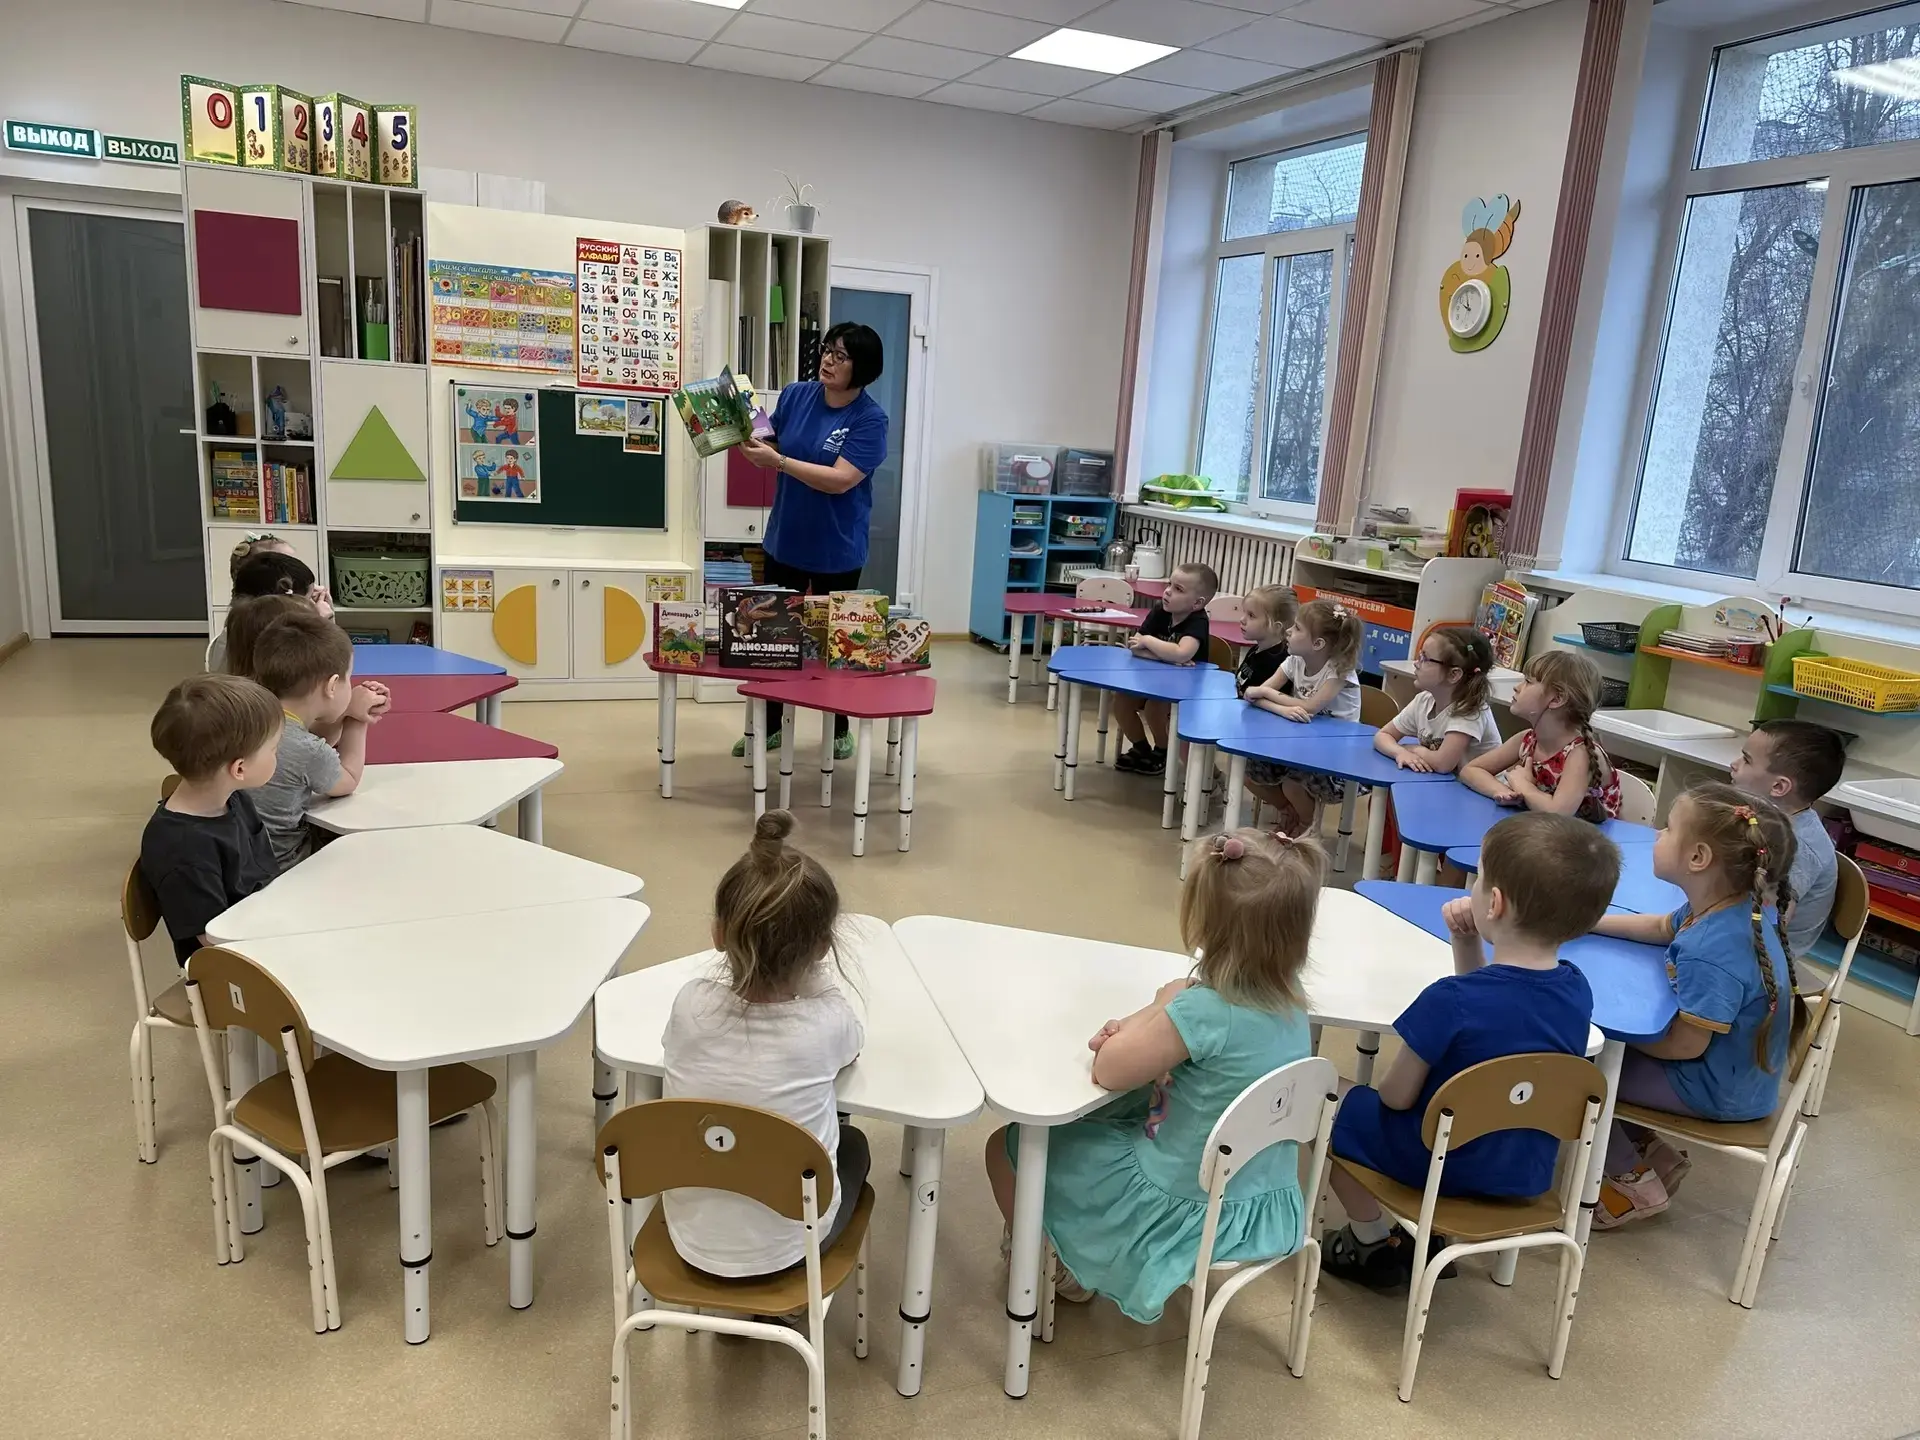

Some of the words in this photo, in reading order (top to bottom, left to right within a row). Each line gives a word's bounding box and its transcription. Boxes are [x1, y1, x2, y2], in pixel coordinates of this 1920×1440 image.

[207, 93, 232, 128] 0
[255, 96, 266, 131] 1
[294, 105, 308, 140] 2
[323, 106, 333, 141] 3
[352, 112, 368, 146] 4
[13, 126, 90, 151] ВЫХОД
[391, 115, 408, 150] 5
[108, 140, 176, 162] ВЫХОД
[579, 243, 619, 254] РУССКИЙ
[579, 252, 618, 262] АЛФАВИТ
[623, 248, 636, 258] Аа
[644, 250, 657, 260] Бб
[665, 252, 676, 262] Вв
[432, 262, 466, 273] Учимся
[583, 264, 592, 273] Гг
[602, 266, 616, 276] Дд
[623, 268, 635, 277] Ее
[662, 272, 678, 282] Жж
[582, 283, 594, 293] Зз
[602, 286, 615, 295] Ии
[644, 290, 656, 299] Кк
[663, 291, 675, 302] Лл
[581, 305, 597, 315] Мм
[603, 307, 615, 317] Нн
[623, 309, 636, 318] Оо
[643, 311, 656, 320] Пп
[664, 313, 675, 324] Рр
[582, 325, 595, 334] Сс
[603, 327, 612, 336] Тт
[623, 329, 635, 340] Уу
[642, 330, 659, 341] Фф
[664, 332, 676, 342] Хх
[582, 345, 596, 355] Цц
[603, 347, 615, 356] Чч
[622, 348, 639, 358] Шш
[641, 350, 659, 360] Щщ
[622, 368, 636, 378] Ээ
[641, 370, 659, 380] Юю
[663, 372, 676, 381] Яя
[662, 610, 693, 619] Динозавры
[694, 609, 702, 617] 3+
[907, 621, 931, 642] ЭТО
[730, 642, 799, 652] ДИНОЗАВРЫ
[1276, 1097, 1282, 1108] 1
[1516, 1090, 1524, 1100] 1
[715, 1136, 724, 1147] 1
[927, 1190, 935, 1201] 1
